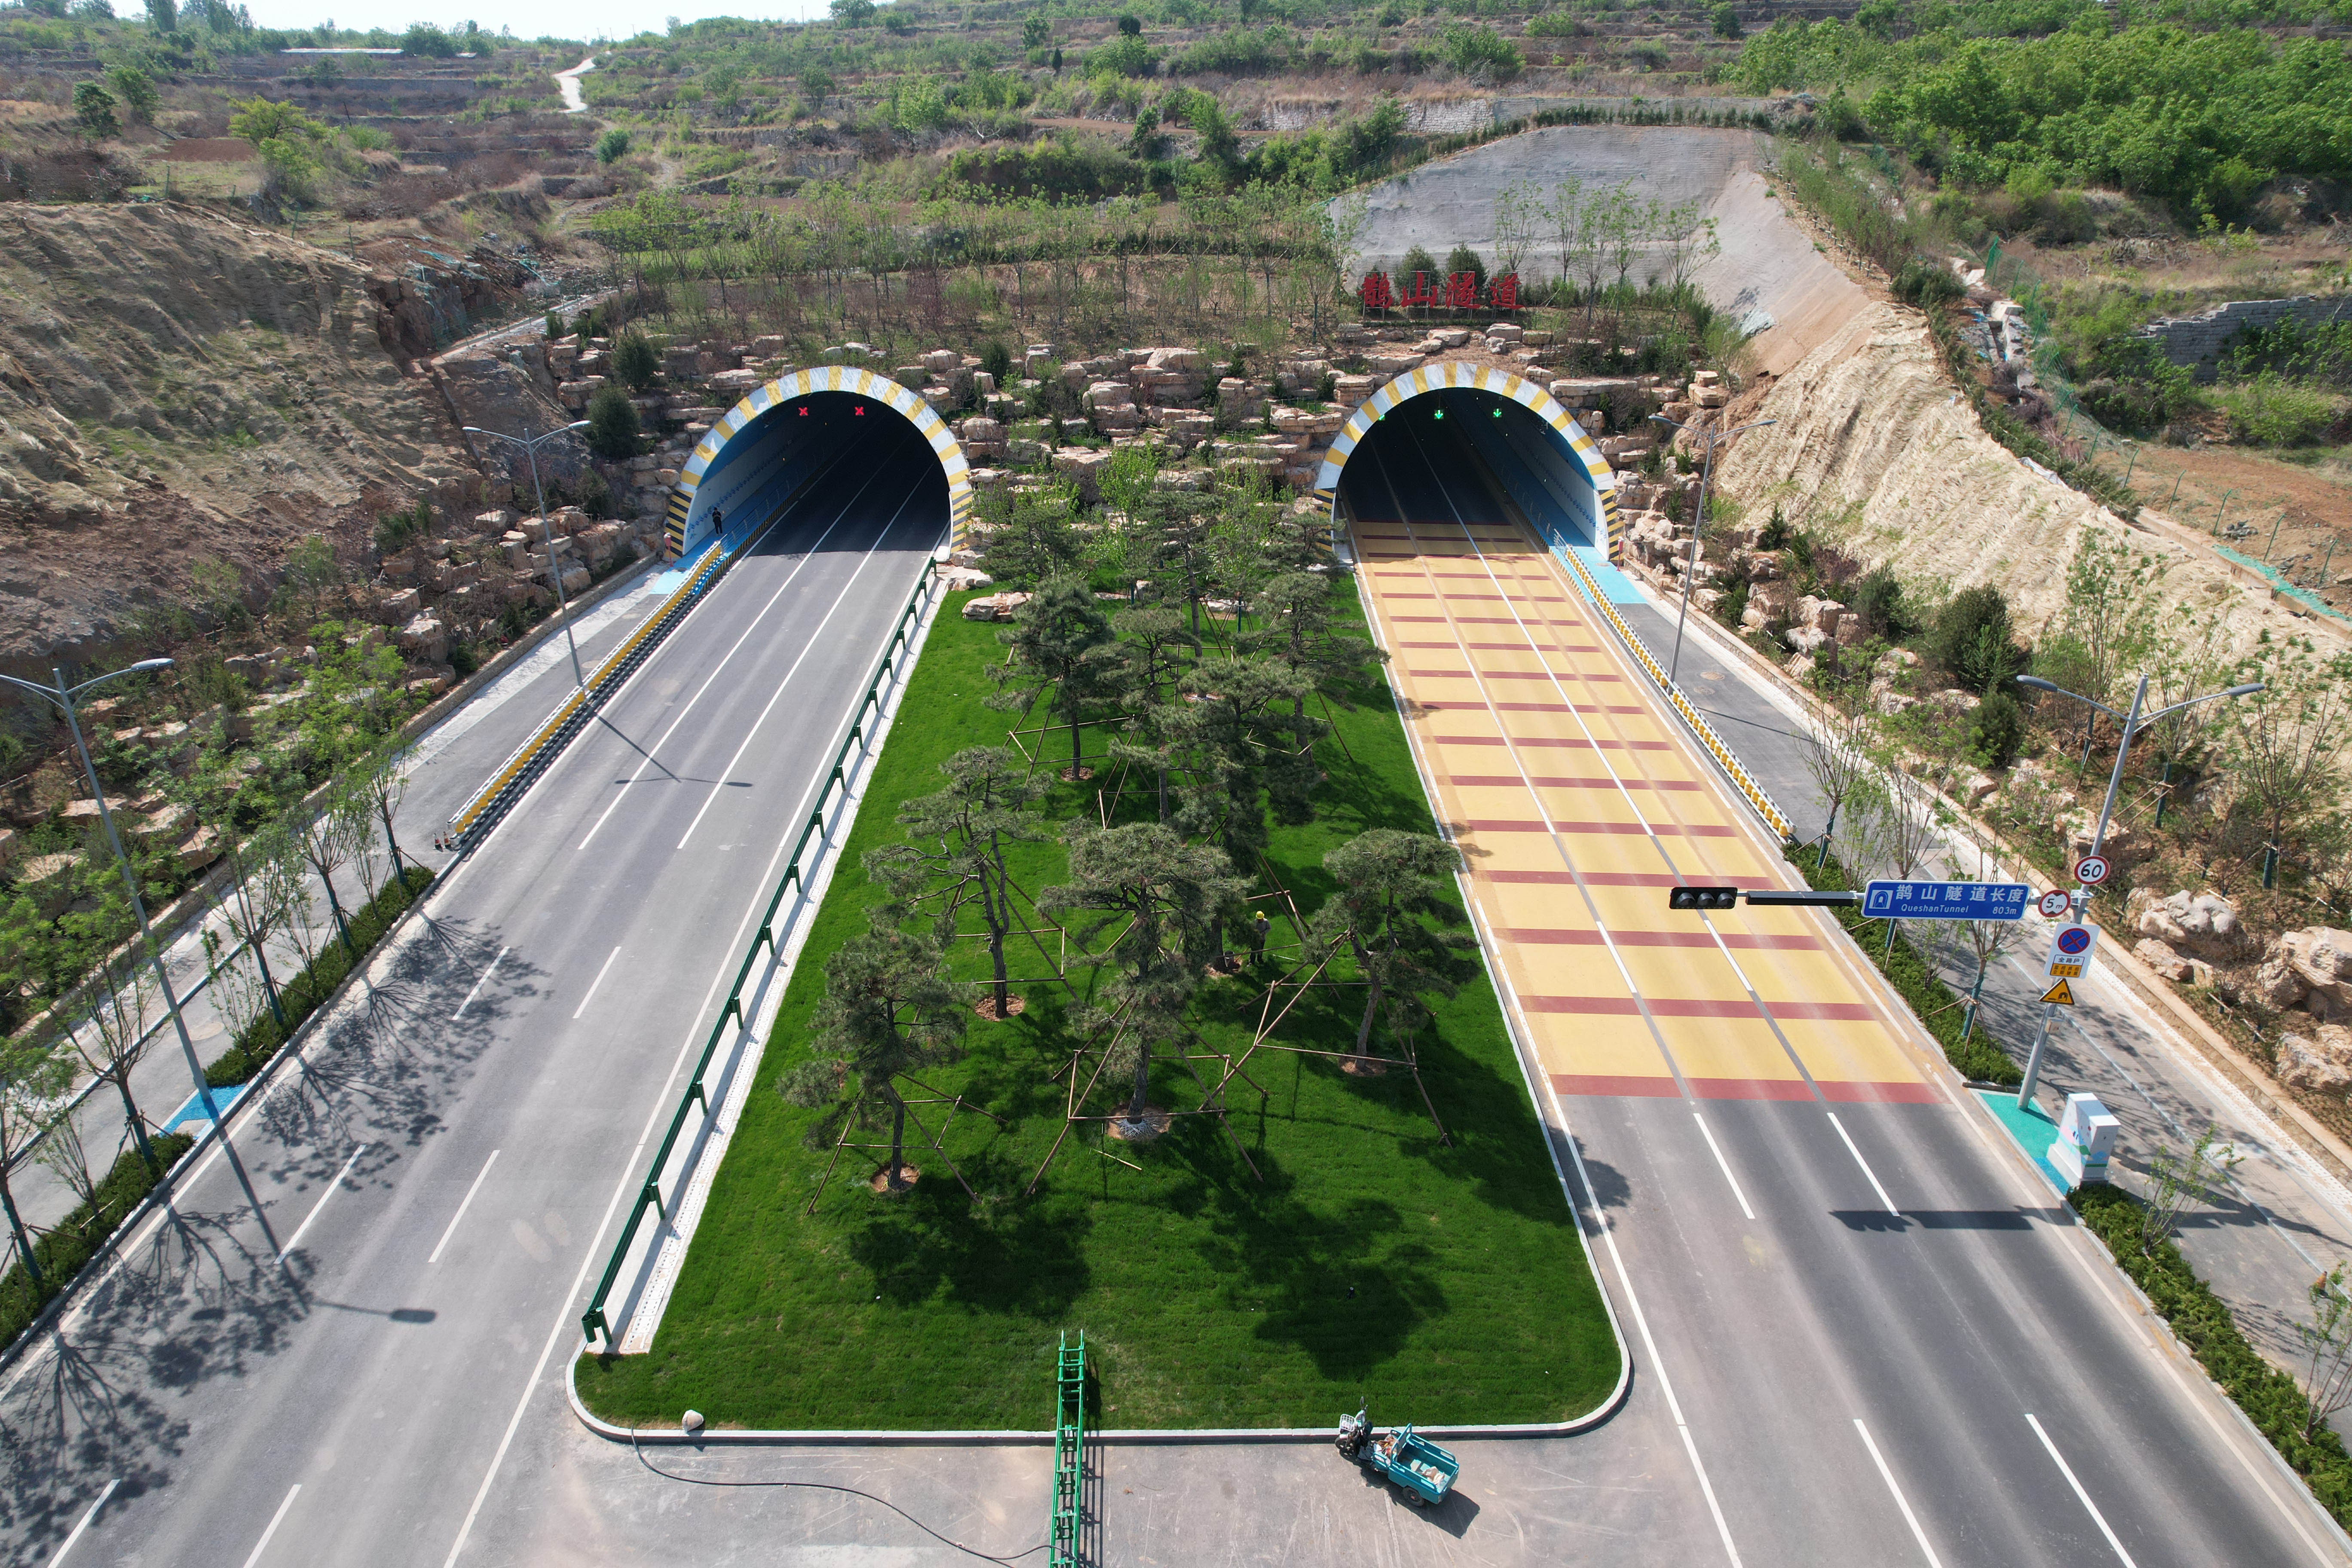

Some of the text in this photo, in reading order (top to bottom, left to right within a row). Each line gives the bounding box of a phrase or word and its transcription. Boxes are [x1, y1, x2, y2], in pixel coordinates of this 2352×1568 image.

[1357, 271, 1525, 309] 鹊山隧道
[2081, 864, 2102, 878] 60
[1896, 884, 2024, 902] 鹊山隧道长度
[1901, 904, 2017, 915] QueshanTunnel 803m
[2046, 898, 2055, 908] 5
